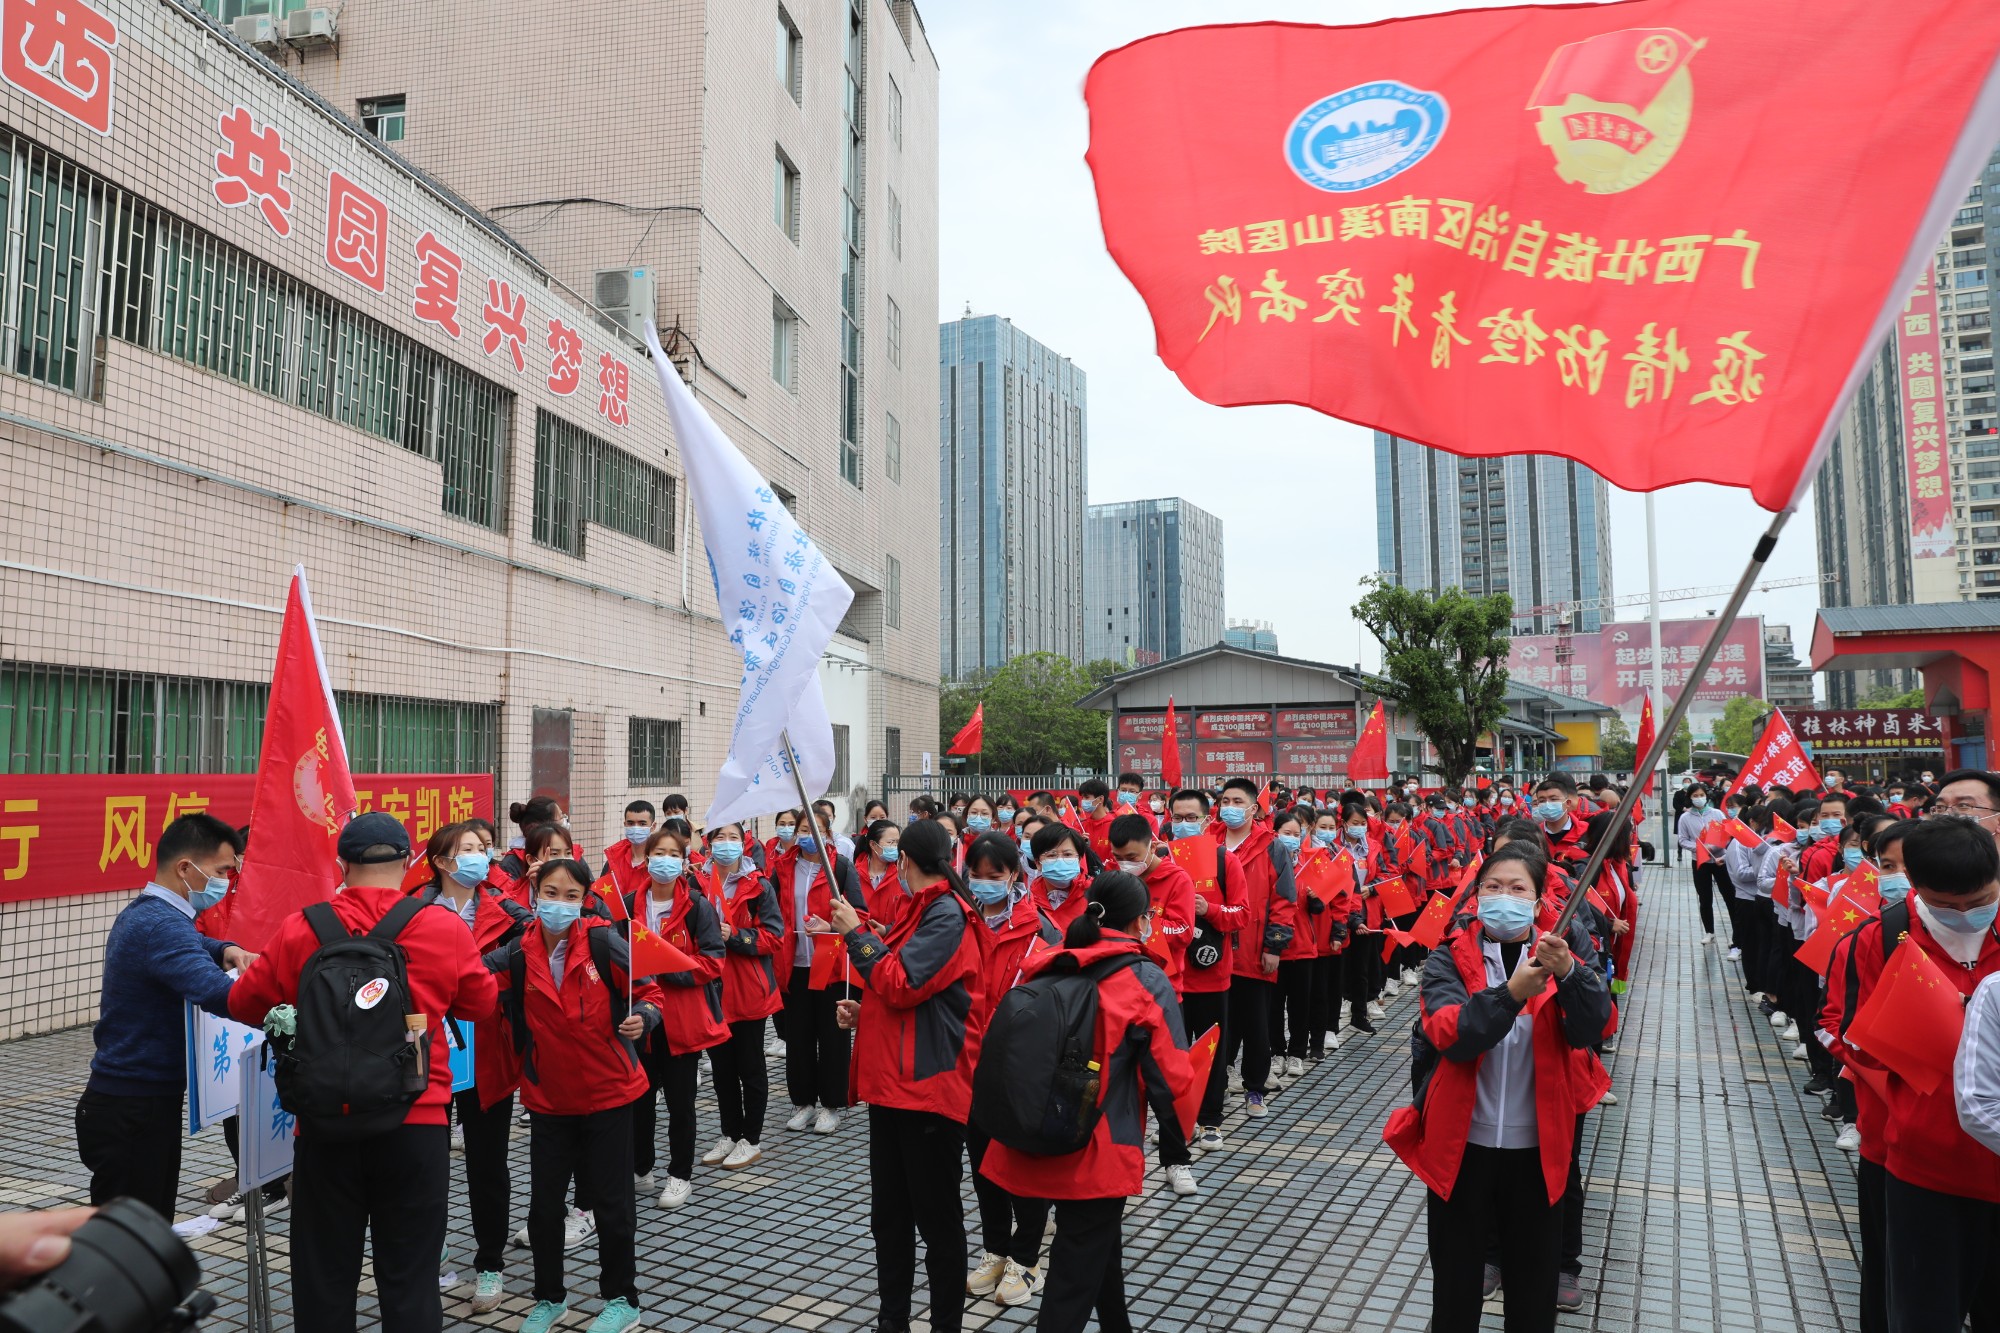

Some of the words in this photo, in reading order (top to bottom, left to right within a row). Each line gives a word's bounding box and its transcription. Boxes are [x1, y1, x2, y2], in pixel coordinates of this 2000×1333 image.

[212, 103, 631, 429] 共圆复兴梦想
[1907, 352, 1945, 499] 共圆复兴梦想
[1206, 751, 1245, 761] 百年征程
[1195, 880, 1213, 889] 广西
